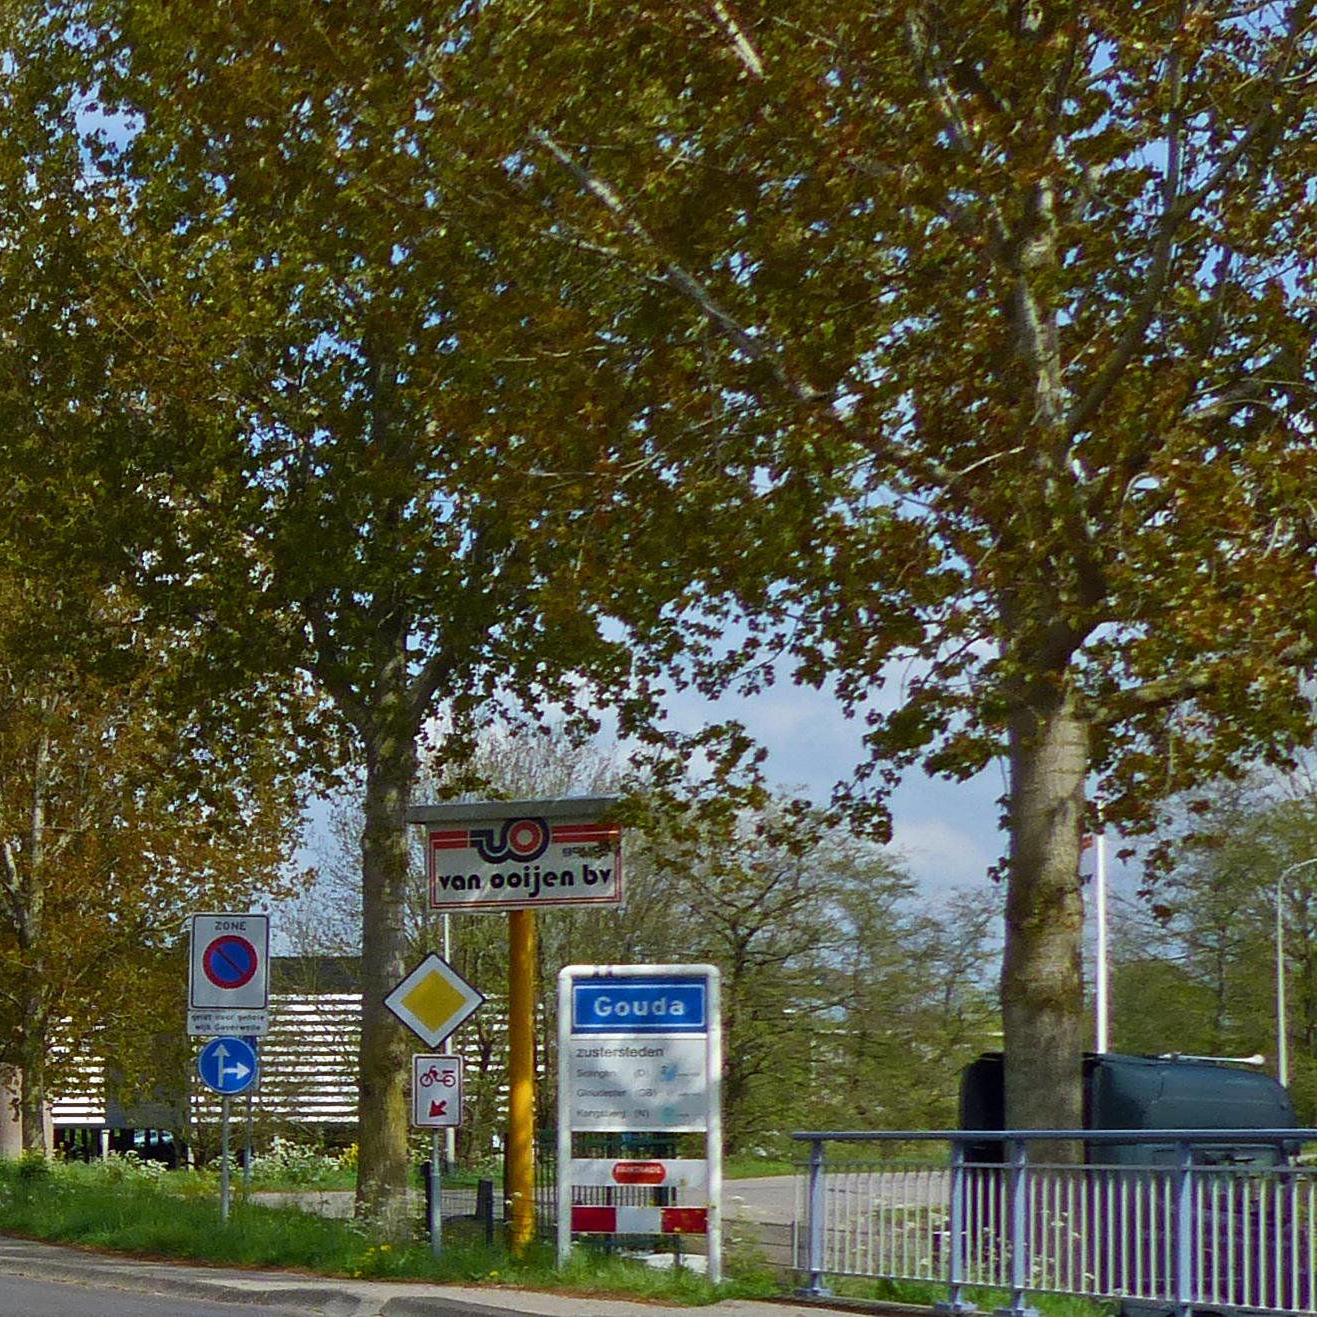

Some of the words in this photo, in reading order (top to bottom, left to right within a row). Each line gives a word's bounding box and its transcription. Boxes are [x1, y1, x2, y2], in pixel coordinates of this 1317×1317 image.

[438, 873, 481, 891] van
[490, 865, 575, 898] ooijen
[583, 863, 613, 886] bv
[214, 920, 246, 931] ZONE
[593, 995, 685, 1017] Gouda
[576, 1045, 664, 1058] zustersteden
